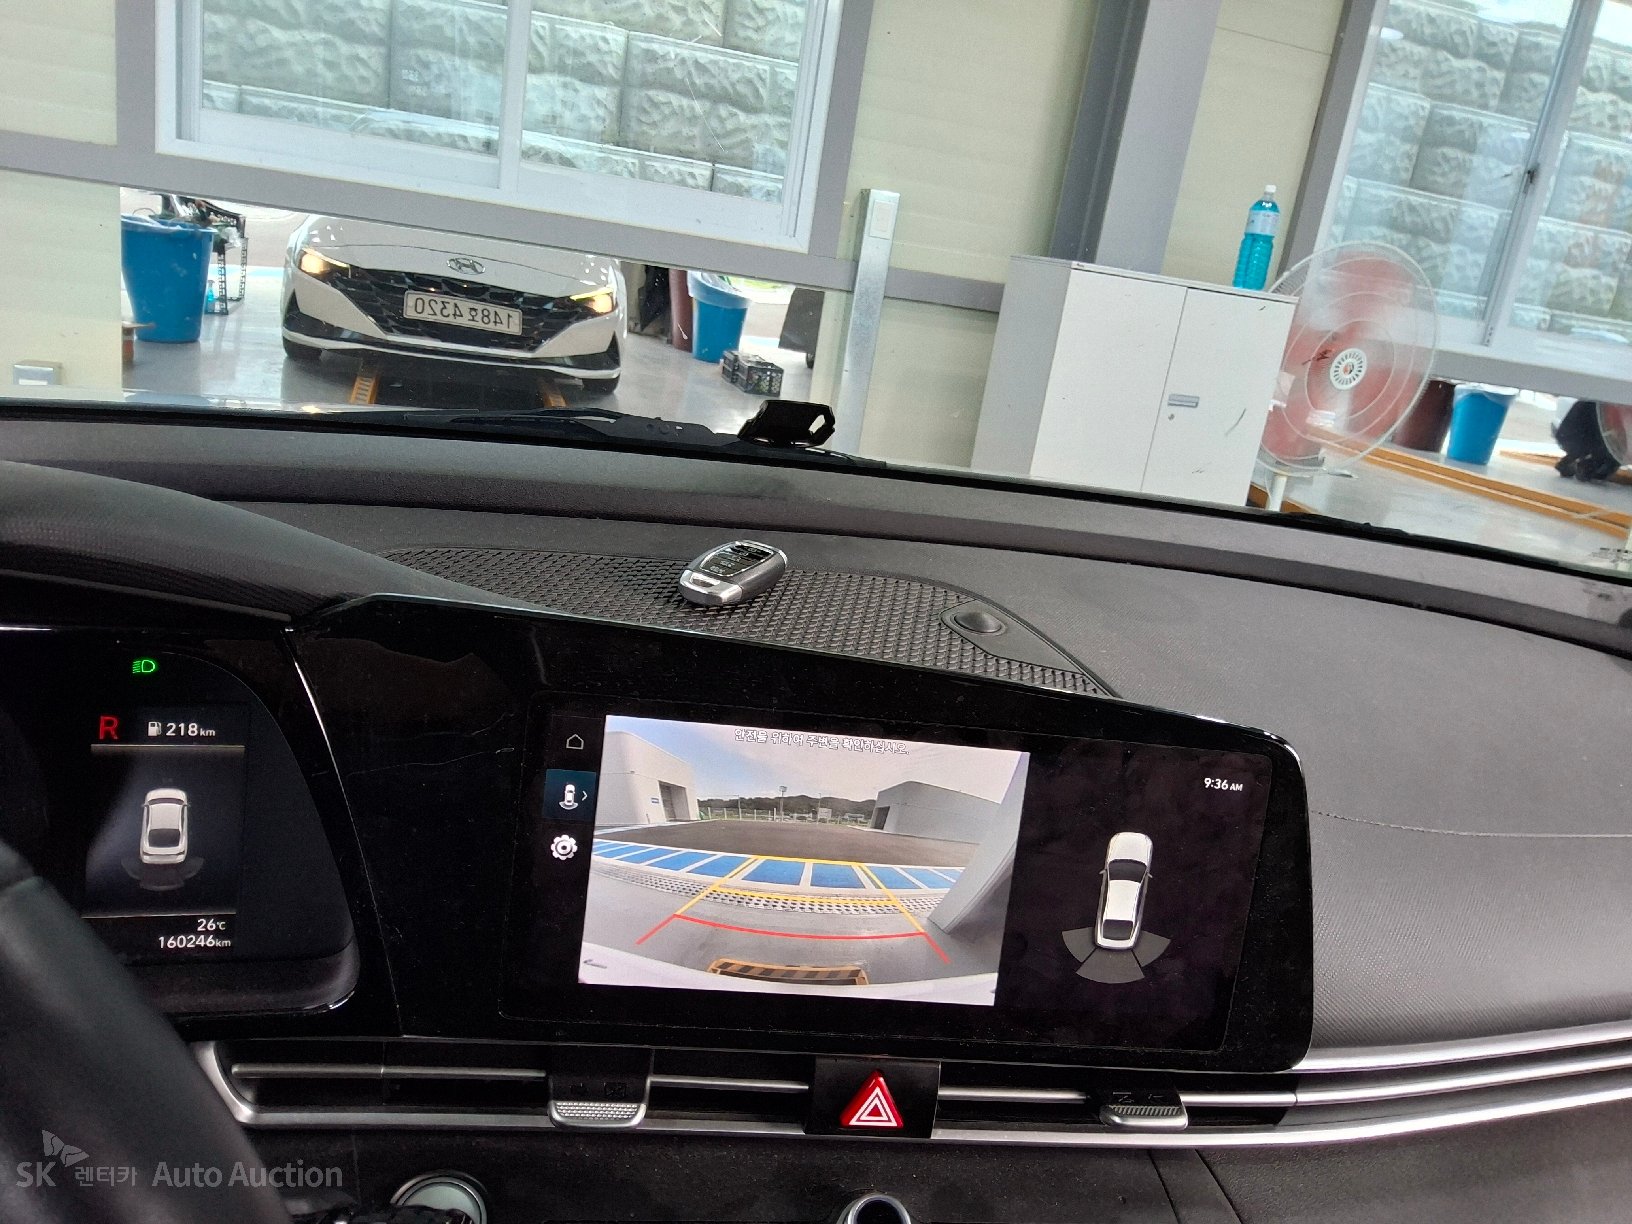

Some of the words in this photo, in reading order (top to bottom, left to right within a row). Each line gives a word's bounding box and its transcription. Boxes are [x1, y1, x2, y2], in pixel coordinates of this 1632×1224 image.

[100, 715, 118, 740] R
[770, 732, 803, 746] 위하여
[806, 735, 839, 749] 주변을
[842, 738, 910, 755] 확인하십시오.
[1204, 777, 1229, 790] 9:36
